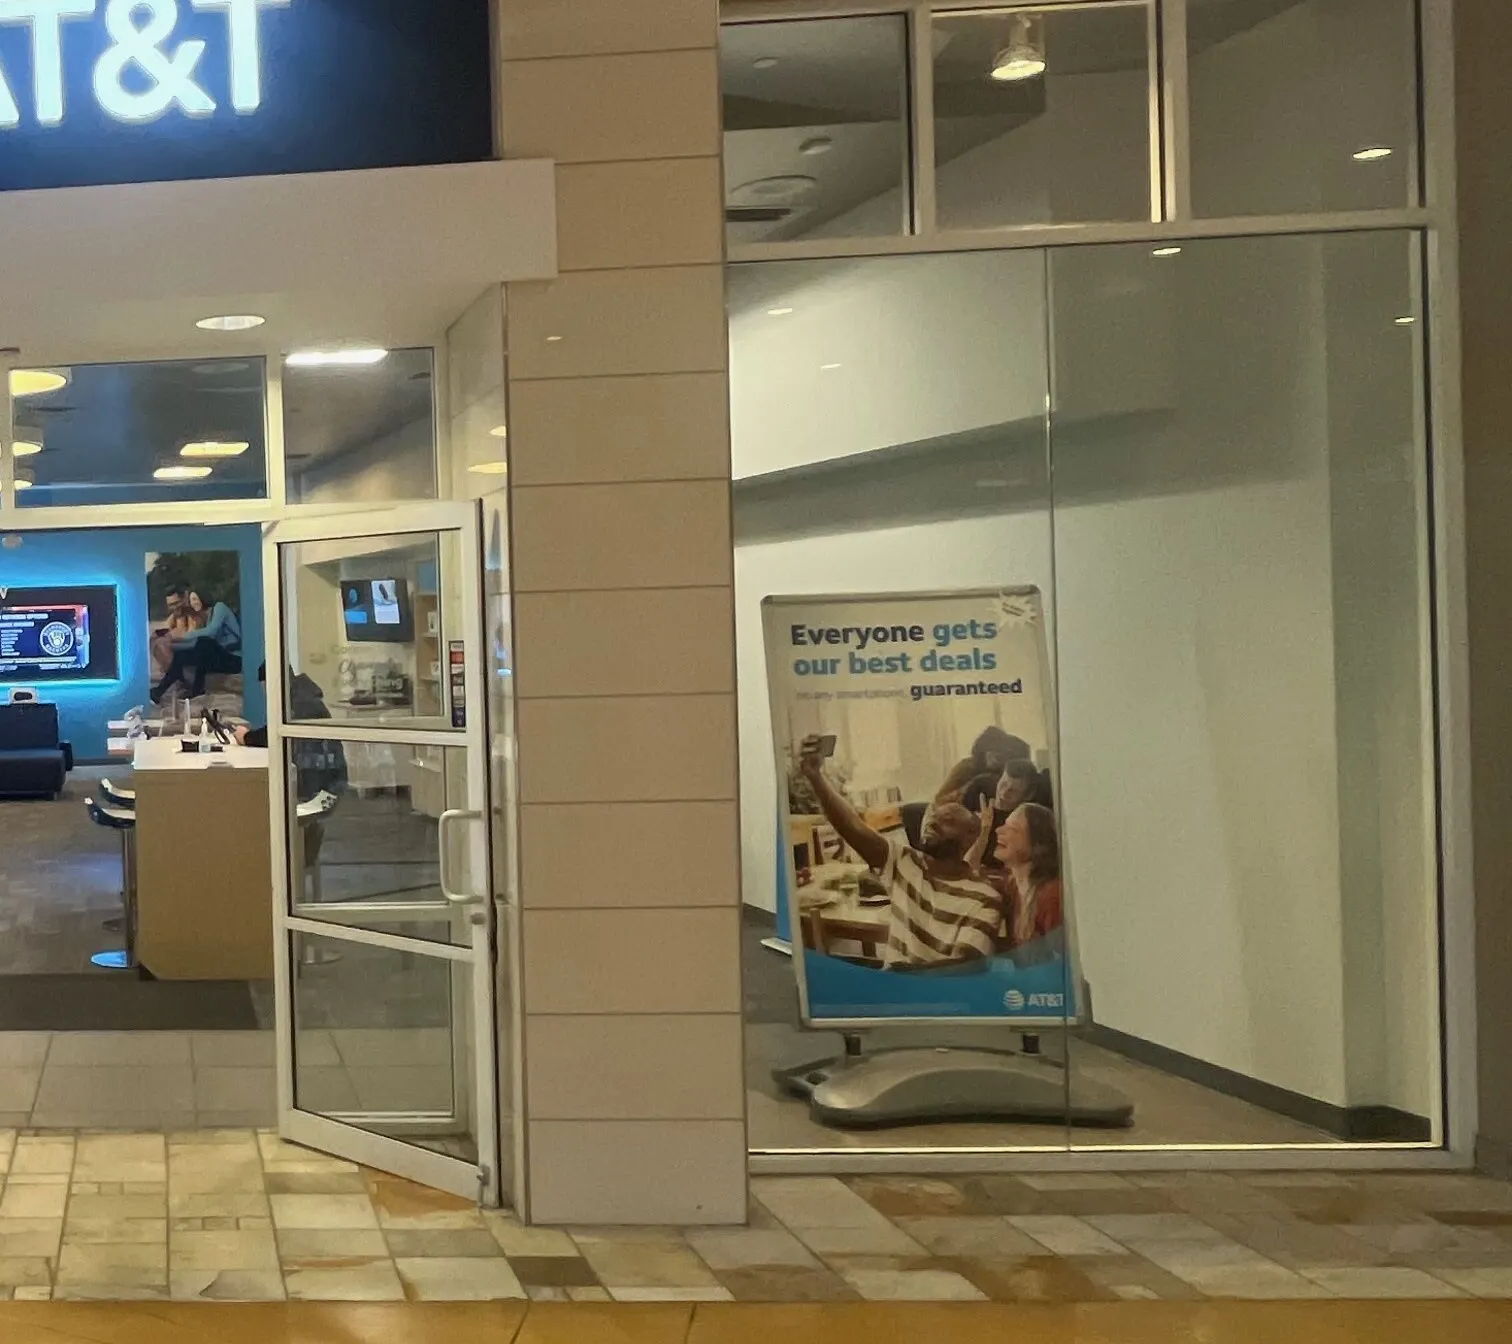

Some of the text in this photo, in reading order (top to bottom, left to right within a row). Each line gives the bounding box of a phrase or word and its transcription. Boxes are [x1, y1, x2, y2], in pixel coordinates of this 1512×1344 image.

[791, 619, 998, 649] Everyone gets
[794, 648, 996, 676] our best deals
[910, 679, 1023, 701] guaranteed
[1027, 992, 1065, 1007] AT&T
